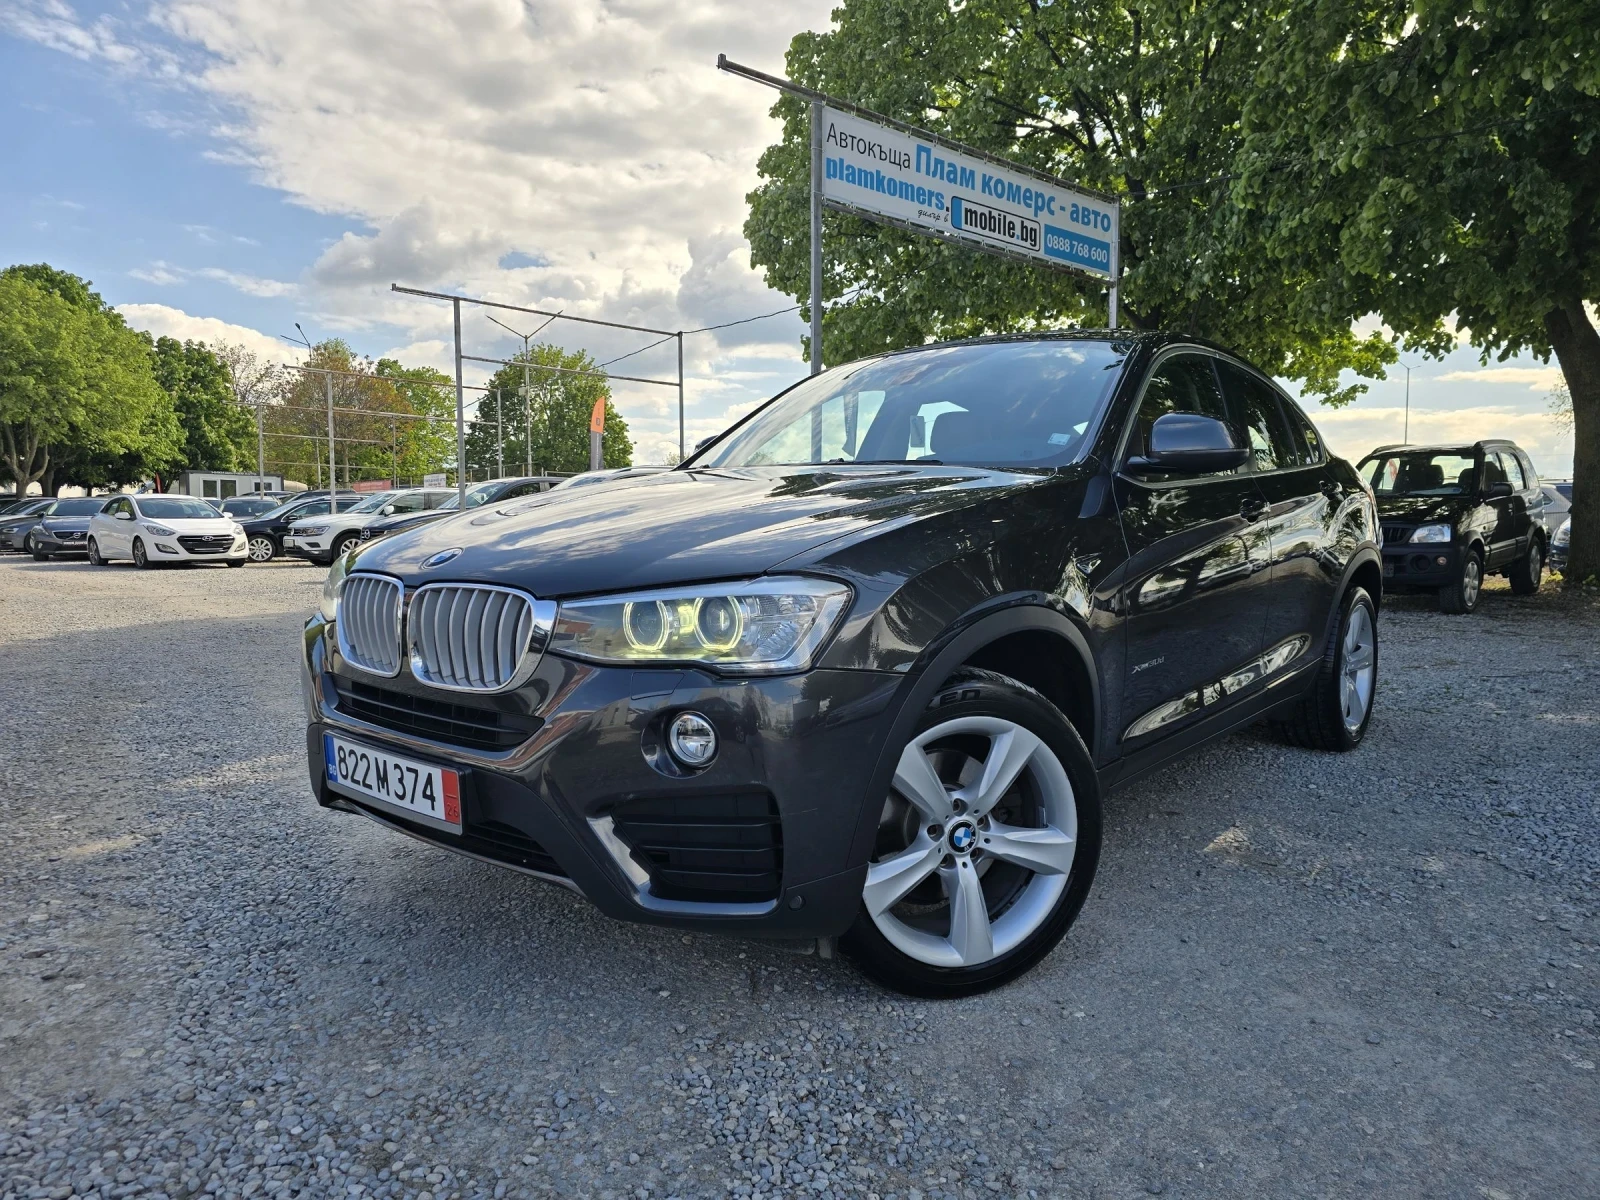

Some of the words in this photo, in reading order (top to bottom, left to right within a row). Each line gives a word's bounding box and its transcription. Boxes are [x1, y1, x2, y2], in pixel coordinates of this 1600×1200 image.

[826, 122, 911, 171] Автокъща
[916, 144, 975, 190] Плам
[981, 173, 1056, 218] комерс
[1070, 203, 1111, 233] авто
[964, 206, 1038, 248] mobile.bg
[1046, 233, 1070, 253] 0888
[1072, 240, 1090, 257] 768
[1090, 244, 1108, 263] 600
[328, 763, 337, 776] BG
[337, 745, 437, 811] 822M374
